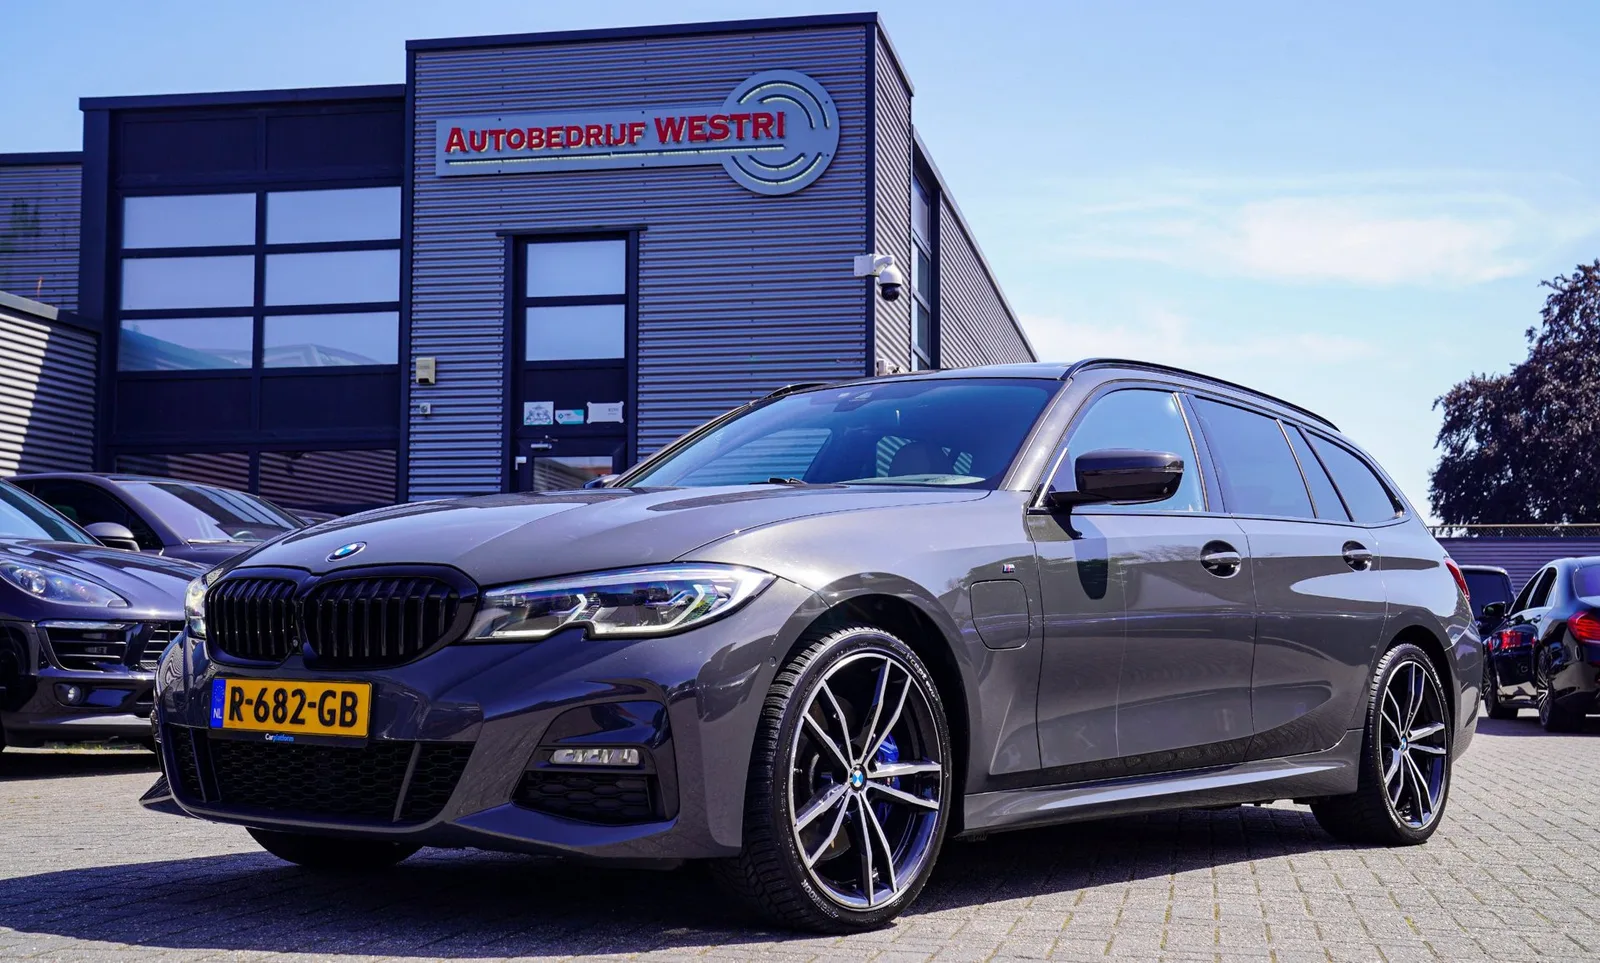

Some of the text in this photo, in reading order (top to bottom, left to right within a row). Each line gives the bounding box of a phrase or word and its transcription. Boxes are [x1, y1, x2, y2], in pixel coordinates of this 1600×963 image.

[444, 111, 786, 154] AUTOBEDRIJF WESTRI
[213, 708, 222, 719] NL
[228, 685, 359, 728] R-682-GB
